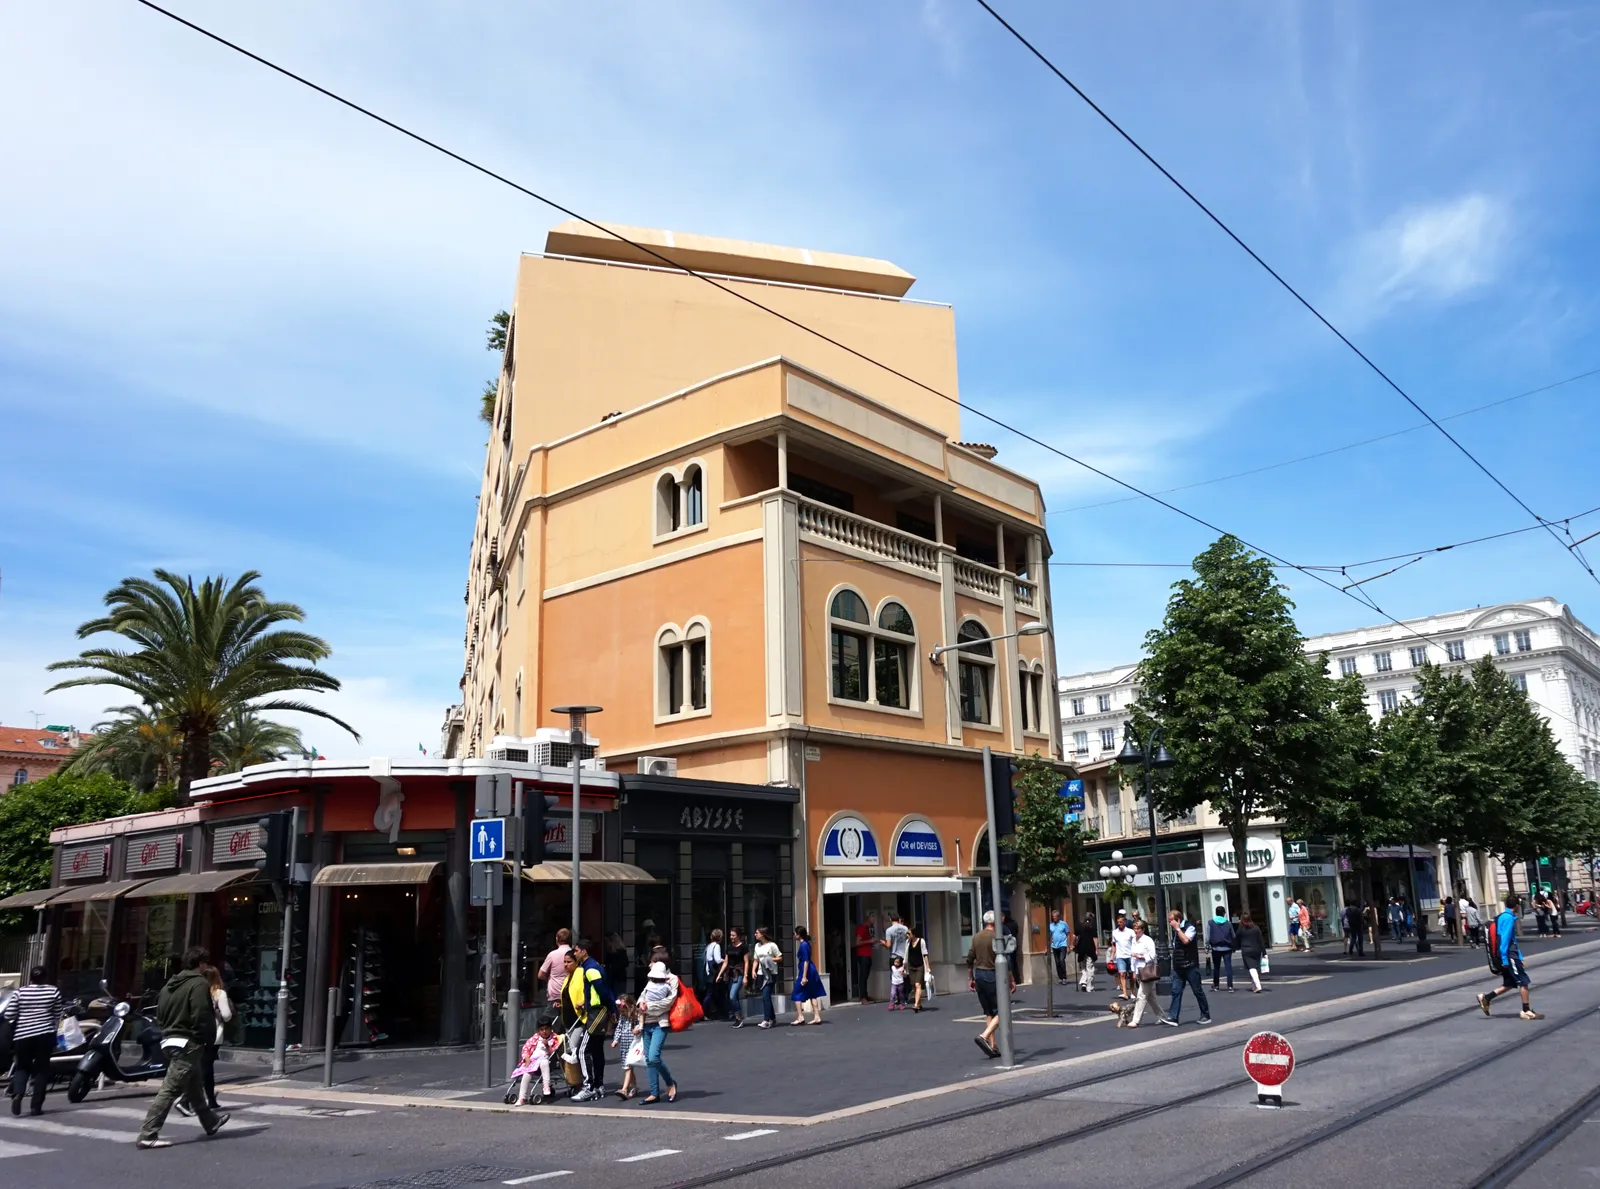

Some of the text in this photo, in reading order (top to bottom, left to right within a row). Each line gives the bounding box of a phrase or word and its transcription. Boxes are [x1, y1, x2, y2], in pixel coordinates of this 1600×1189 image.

[680, 806, 744, 831] ABYSSE
[543, 822, 567, 843] irls
[901, 841, 909, 849] OR
[917, 842, 937, 850] DEVISES
[1217, 848, 1272, 865] MEPISTO
[1298, 865, 1317, 876] MEPHISTO
[1148, 873, 1175, 886] MHISTO
[1081, 882, 1105, 892] MEPHISTO
